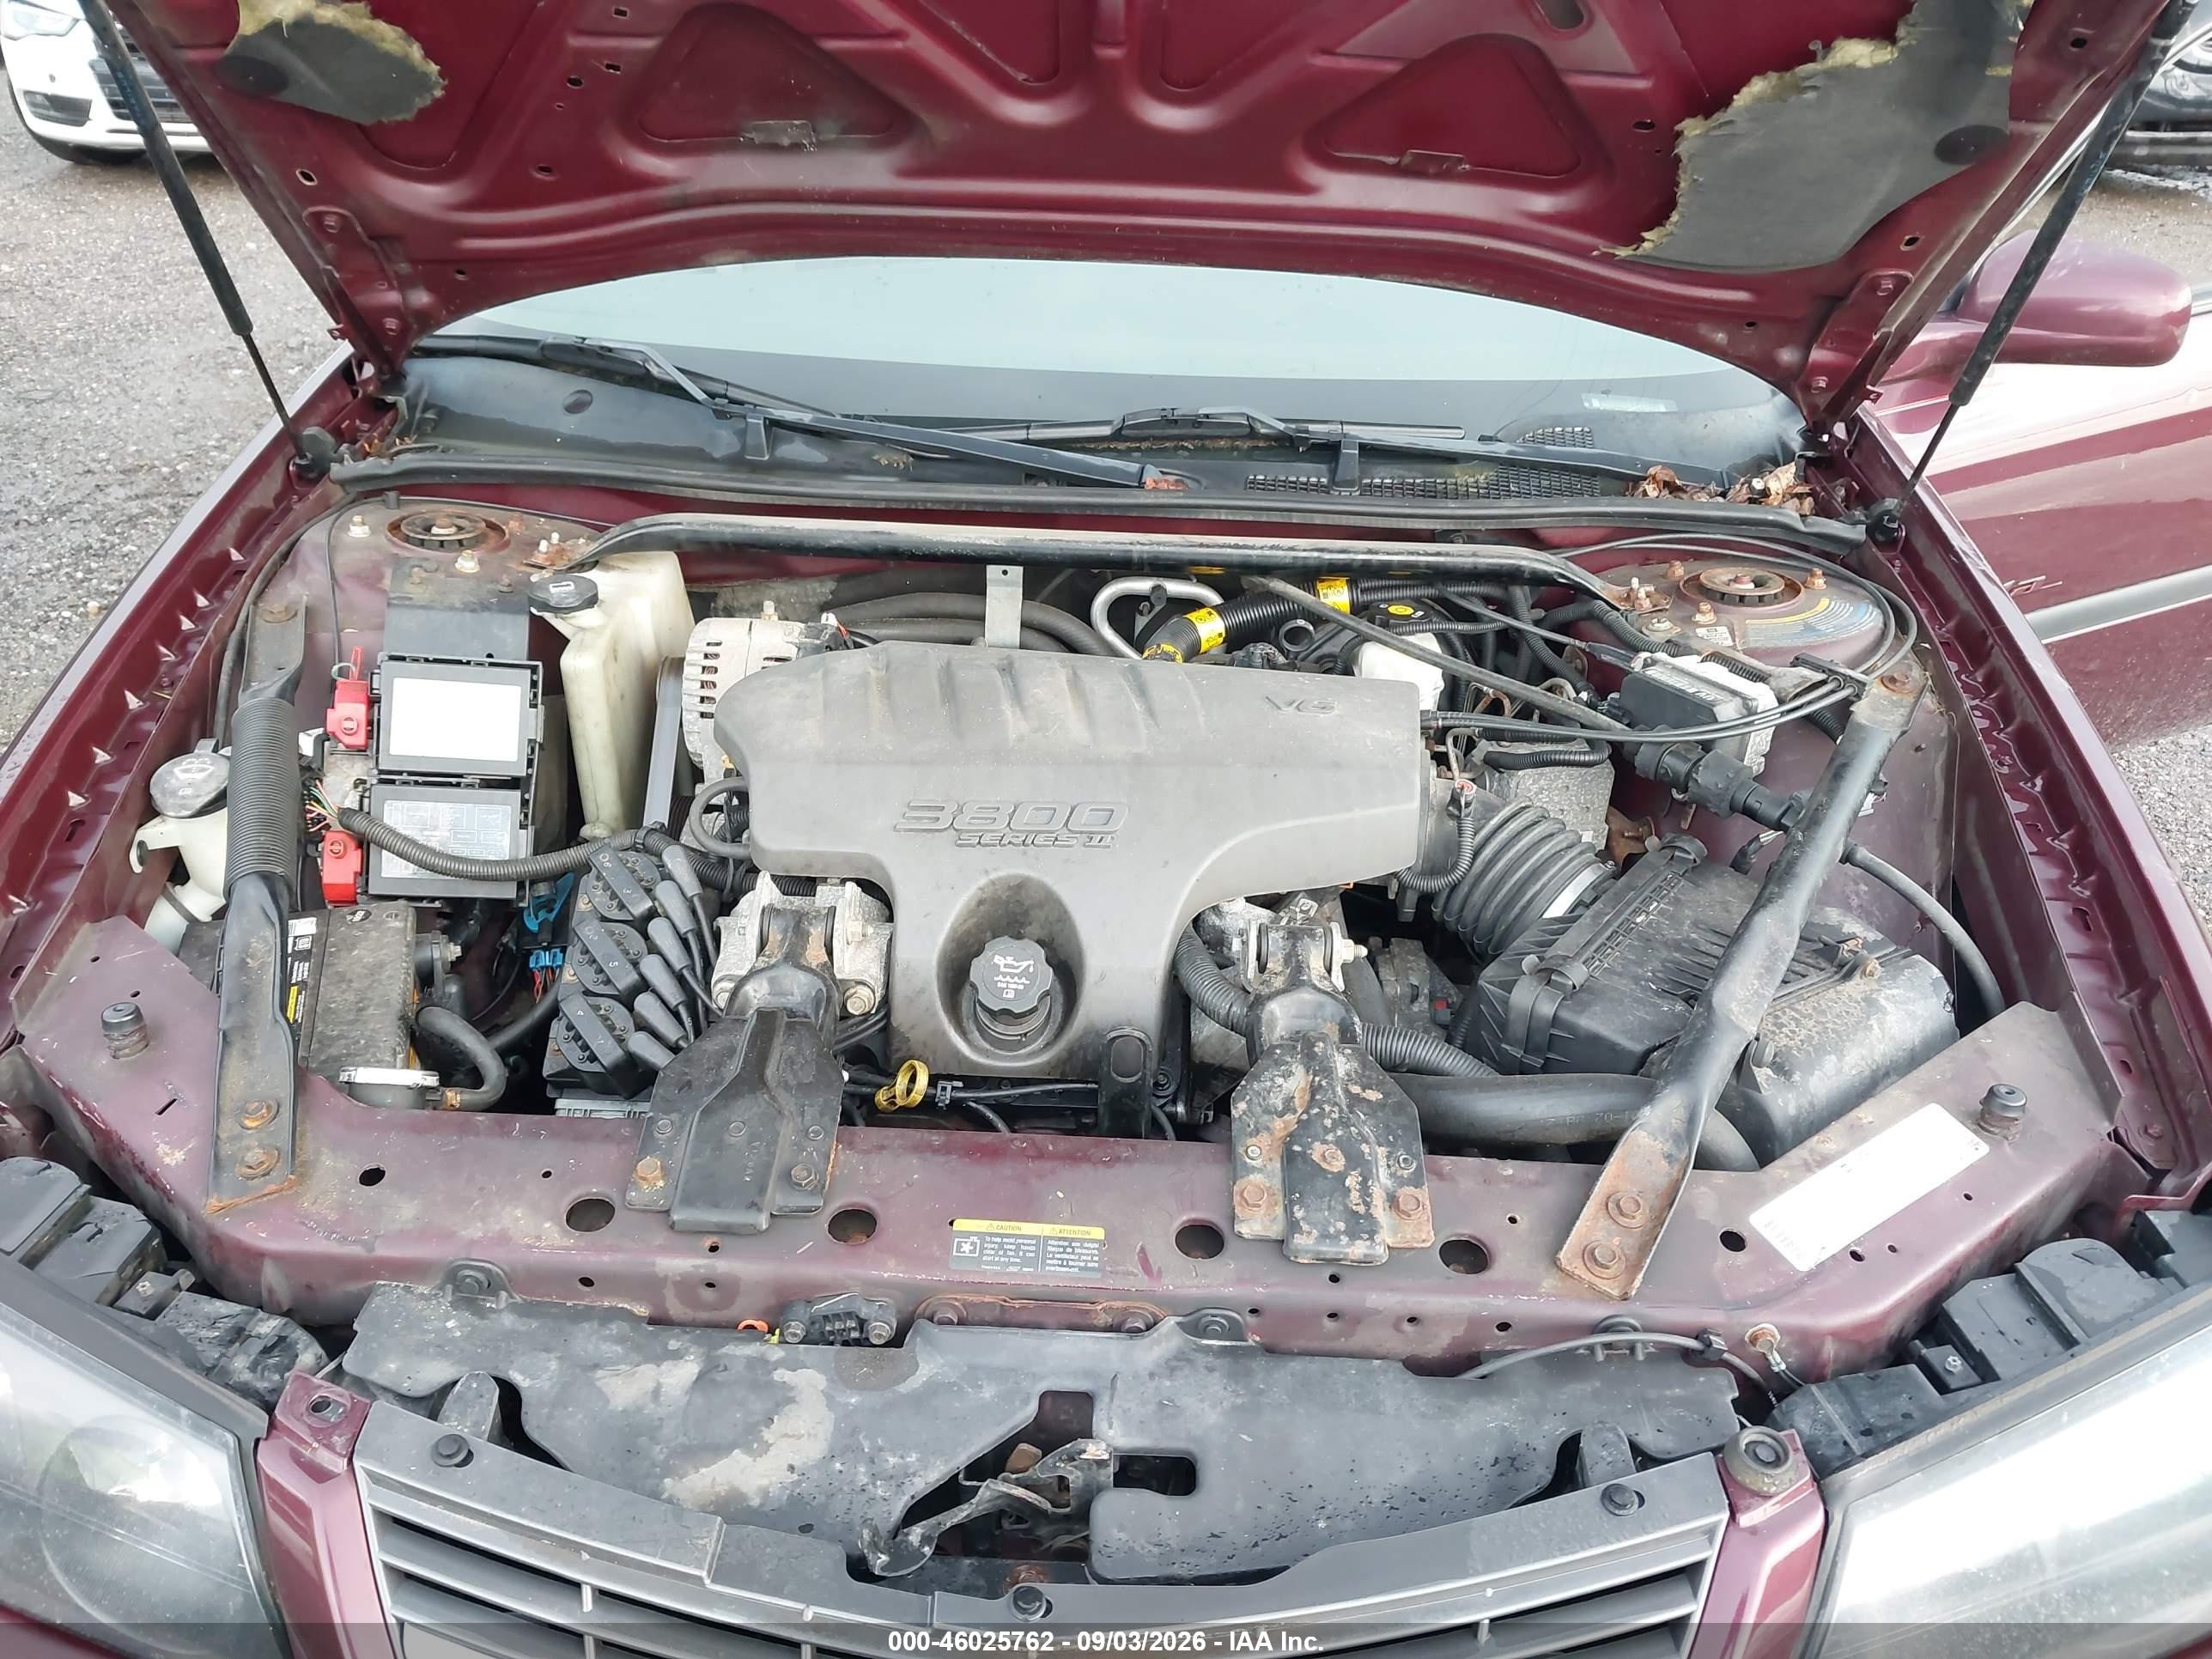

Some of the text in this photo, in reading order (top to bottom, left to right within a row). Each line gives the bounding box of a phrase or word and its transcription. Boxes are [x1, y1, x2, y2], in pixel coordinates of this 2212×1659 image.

[1265, 695, 1339, 715] V6
[893, 799, 1130, 832] 3800
[954, 832, 1115, 848] SERIES II
